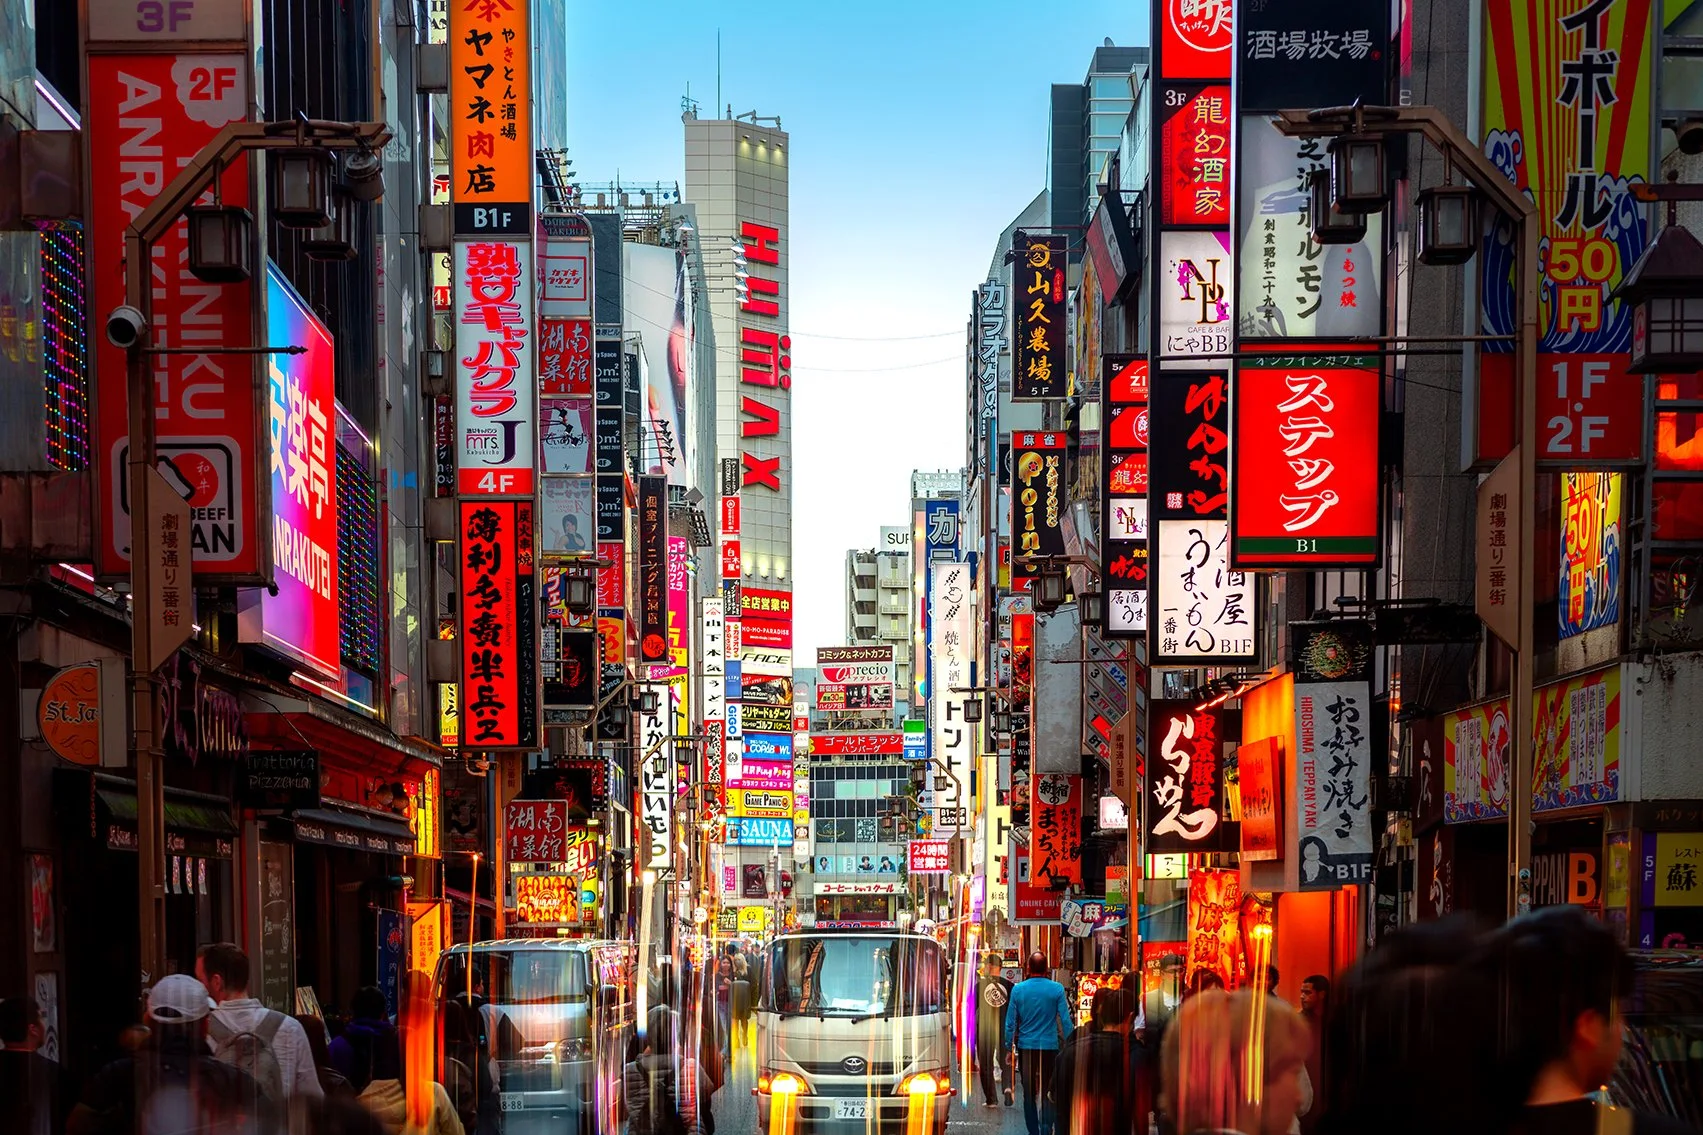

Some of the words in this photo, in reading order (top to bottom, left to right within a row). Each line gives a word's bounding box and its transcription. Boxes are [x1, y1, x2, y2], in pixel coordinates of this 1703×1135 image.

[137, 2, 193, 32] 3F
[1247, 29, 1373, 60] 酒場牧場
[188, 67, 236, 100] 2F
[500, 28, 517, 141] やきとん酒場
[1165, 90, 1187, 106] 3F
[463, 29, 496, 195] ヤマネ肉店
[1193, 96, 1227, 215] 龍幻酒家
[474, 207, 512, 228] B1F
[1263, 218, 1276, 322] 創業昭和二十九年
[1548, 239, 1616, 283] 50
[461, 243, 528, 418] 熟女キャバクラ
[1026, 271, 1052, 381] 山久農場
[1167, 335, 1228, 353] にゃBB
[1552, 361, 1610, 399] 1F
[482, 420, 527, 465] J
[1023, 434, 1055, 446] 麻雀
[1547, 416, 1609, 453] 2F
[1276, 375, 1339, 532] ステップ
[478, 471, 515, 493] 4F
[602, 486, 619, 494] Space
[1045, 455, 1060, 528] MAHJONG
[517, 509, 533, 567] 炭火串焼
[1296, 540, 1317, 552] B1
[1489, 492, 1507, 606] 劇場通り一番街
[161, 513, 180, 627] 劇場通り一番街
[1214, 523, 1249, 625] 酒屋
[741, 595, 790, 612] 全店営業中
[1181, 529, 1215, 652] うまいもん
[1162, 608, 1179, 654] 一番街
[1220, 639, 1252, 653] B1F
[741, 653, 790, 665] FACE
[819, 649, 891, 660] コミック&ネットカフェ
[45, 700, 99, 722] St.Ja
[728, 705, 737, 735] GiGO
[741, 706, 791, 720] ビリヤード&ダーツ
[1301, 696, 1315, 754] HIROSHIMA
[825, 736, 903, 746] ゴールドラッシ
[841, 745, 881, 753] ハンバーグ
[1190, 713, 1216, 807] 東京豚骨
[1321, 694, 1368, 840] お好み焼き
[644, 700, 668, 857] んかにいむら
[1303, 760, 1317, 828] TEPPANYAKI
[741, 820, 792, 838] SAUNA
[1655, 808, 1698, 822] ポケッ
[913, 845, 948, 856] 24時間
[913, 857, 948, 869] 営業中
[1336, 863, 1371, 881] B1F
[823, 884, 852, 893] コーヒー
[1104, 905, 1123, 913] フリー
[843, 1106, 872, 1117] 74-2
